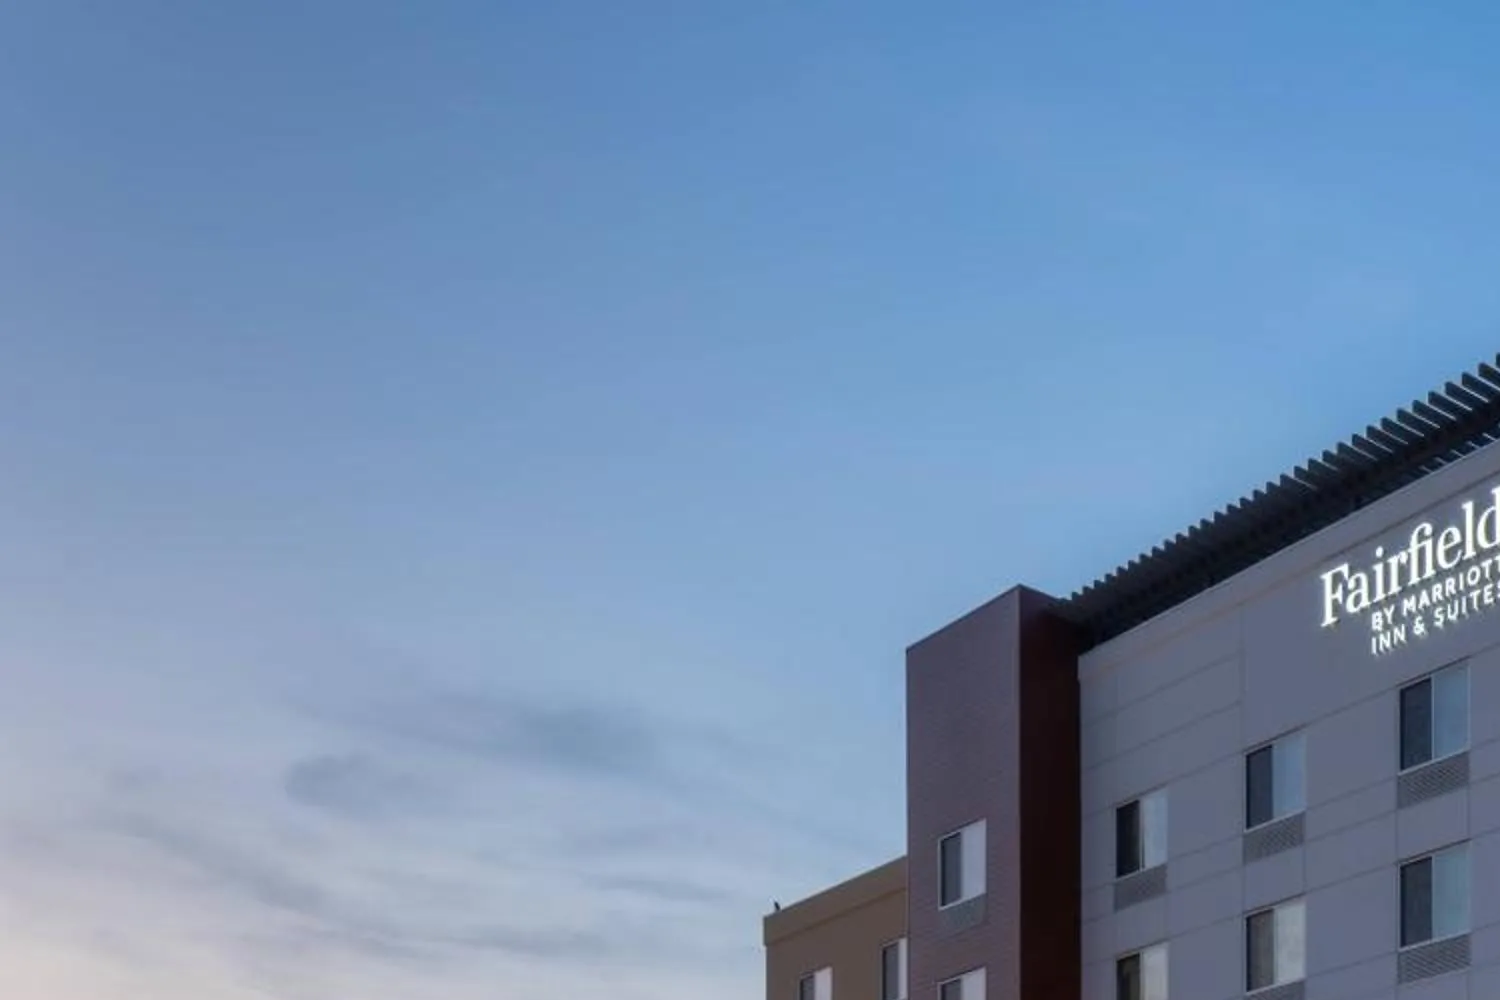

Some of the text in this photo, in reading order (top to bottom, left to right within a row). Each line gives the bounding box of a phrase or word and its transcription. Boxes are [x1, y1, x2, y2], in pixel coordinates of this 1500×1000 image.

[1371, 605, 1395, 631] BY
[1371, 624, 1406, 655] INN
[1413, 615, 1426, 635] &
